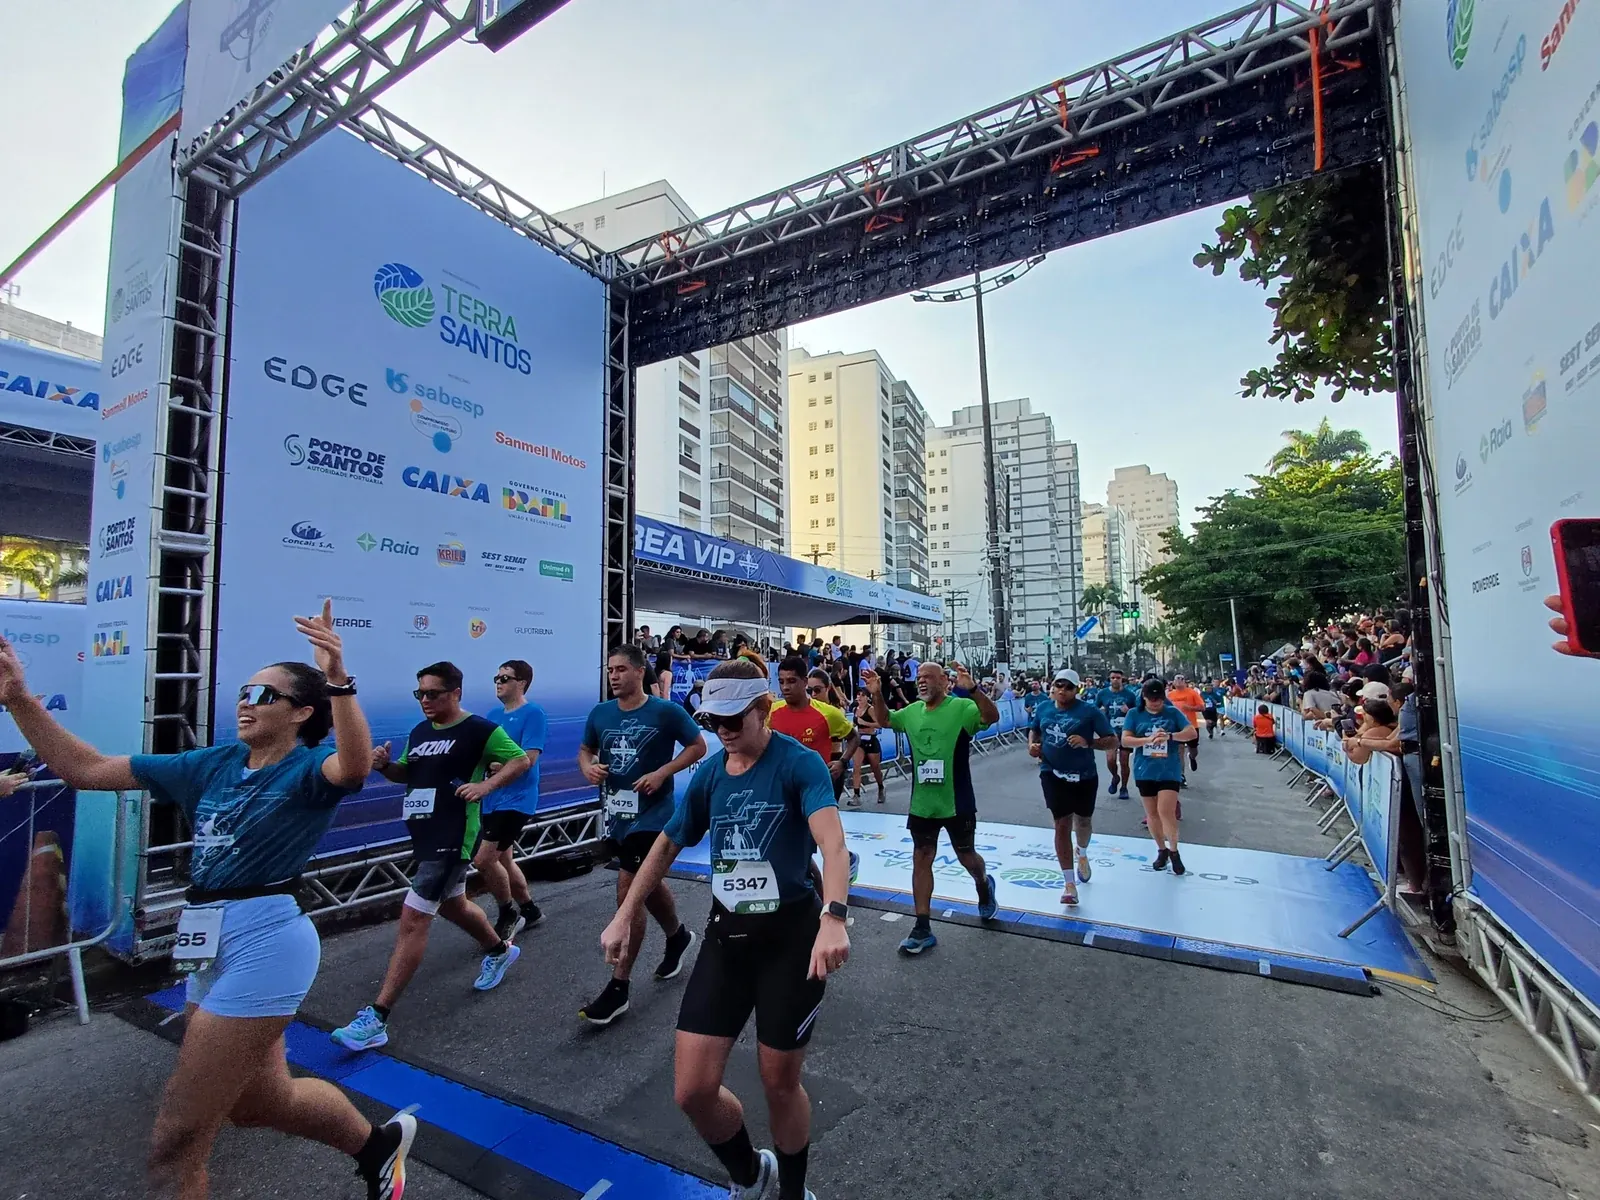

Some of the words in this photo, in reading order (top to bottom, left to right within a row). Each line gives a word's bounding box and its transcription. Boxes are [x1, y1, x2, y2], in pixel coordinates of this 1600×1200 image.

[1479, 33, 1526, 150] sabesp
[1430, 208, 1464, 300] EDGE
[1488, 195, 1554, 321] CAIXA
[441, 283, 519, 343] TERRA
[440, 314, 532, 376] SANTOS
[111, 343, 143, 378] EDGE
[264, 356, 368, 407] EDGE
[414, 382, 485, 419] sabesp
[1490, 417, 1512, 454] Raia
[308, 437, 363, 459] PORTO
[366, 451, 386, 466] DE
[495, 431, 549, 458] Sanmell
[551, 448, 587, 469] Motos
[306, 465, 347, 478] AUTORIDADE
[307, 450, 385, 479] SANTOS
[402, 466, 490, 504] CAIXA
[509, 480, 539, 492] GOVERNO
[541, 488, 567, 499] FEDERAL
[502, 487, 572, 523] BRASIL
[107, 520, 126, 536] PORTO
[127, 517, 136, 529] DE
[106, 531, 134, 551] SANTOS
[282, 537, 315, 547] Concais
[319, 542, 335, 550] S.A.
[380, 537, 420, 556] Raia
[694, 539, 735, 570] VIP
[439, 549, 465, 562] KRILL
[481, 551, 501, 561] SEST
[503, 555, 527, 565] SENAT
[96, 575, 133, 602] CAIXA
[1472, 573, 1500, 594] POWERADE
[408, 740, 456, 756] AZON
[404, 800, 429, 808] 2030
[611, 799, 633, 808] 4475
[723, 877, 768, 892] 5347
[178, 932, 207, 947] 65
